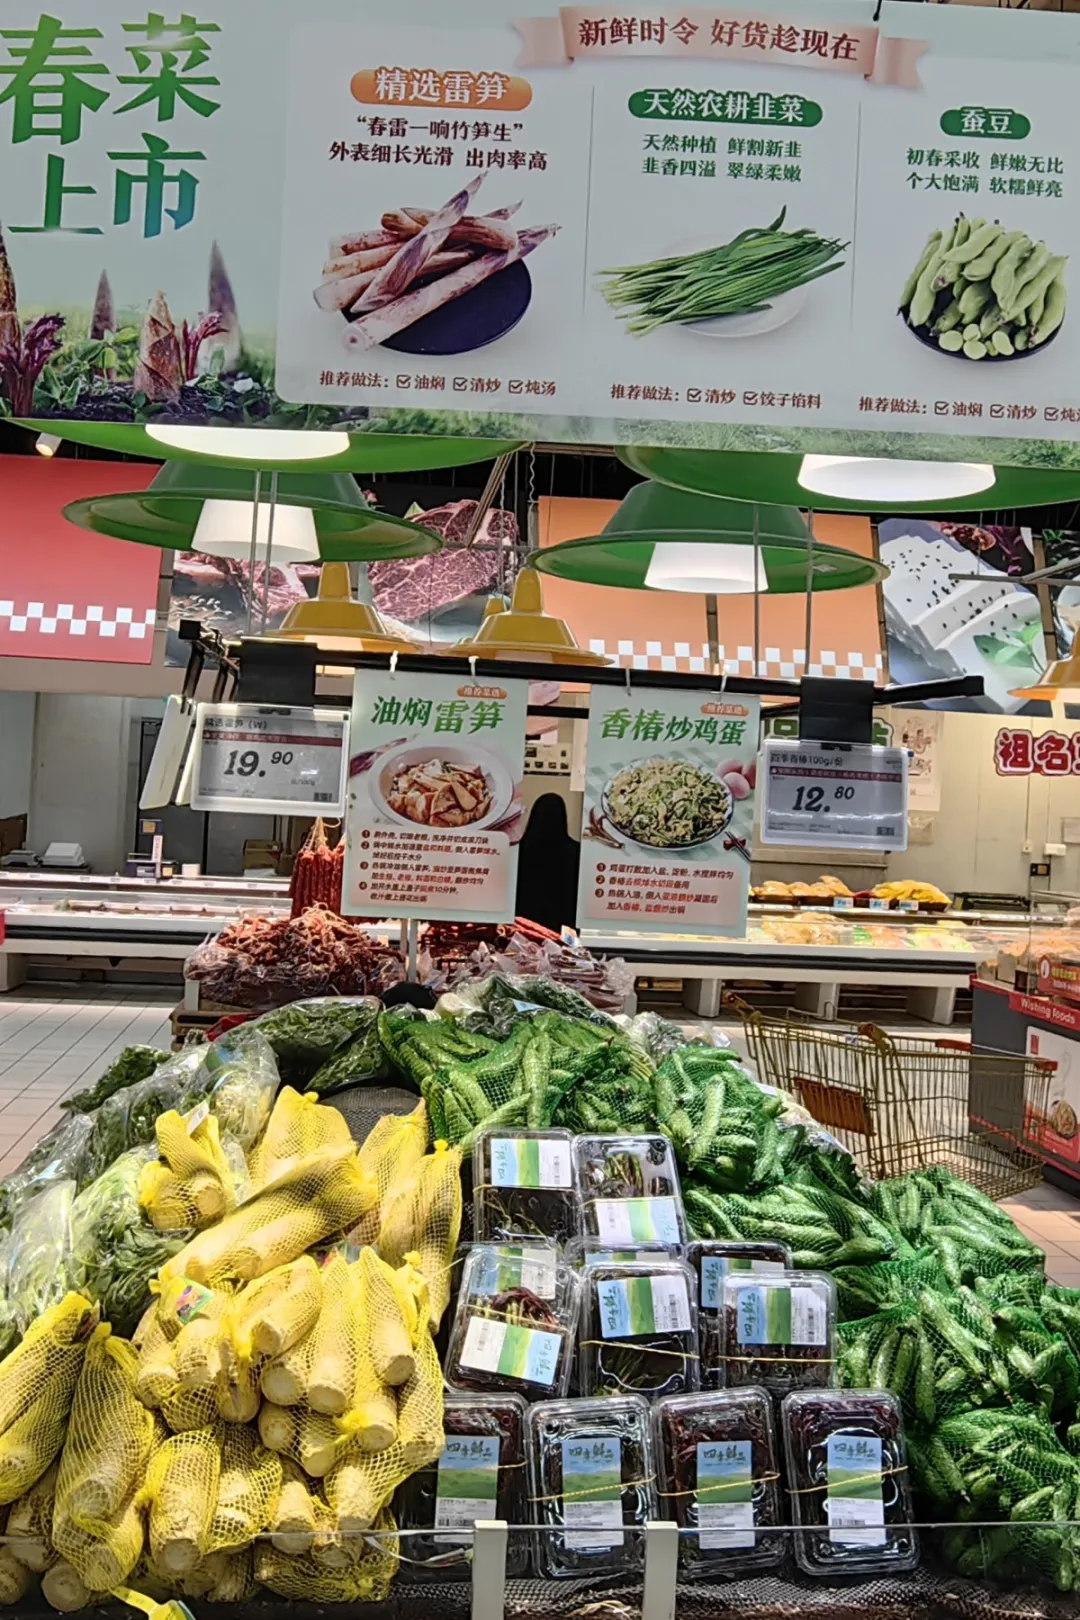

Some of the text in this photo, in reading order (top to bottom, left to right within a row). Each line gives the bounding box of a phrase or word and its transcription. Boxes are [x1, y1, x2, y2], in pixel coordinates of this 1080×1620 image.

[578, 16, 860, 61] 新鲜时令 好货趁现在
[0, 12, 222, 145] 春菜
[375, 68, 507, 104] 精选雷笋
[643, 90, 804, 123] 天然农耕韭菜
[961, 108, 1013, 135] 蚕豆
[329, 141, 548, 171] 外表细长光滑 出肉率高
[643, 133, 802, 158] 天然种植 鲜割新韭
[642, 157, 801, 182] 韭香四溢 翠绿柔嫩
[906, 148, 1064, 174] 初春采收 鲜嫩无比
[8, 132, 207, 239] 上市
[906, 172, 1063, 198] 个大饱满 软糯鲜亮
[414, 375, 446, 391] 油焖
[470, 378, 501, 393] 清炒
[525, 380, 556, 396] 炖汤
[705, 389, 736, 404] 清炒
[760, 391, 822, 409] 饺子馅料
[952, 401, 983, 417] 油焖
[1007, 404, 1038, 420] 清炒
[1060, 408, 1080, 422] 炖
[371, 696, 505, 734] 油焖雷笋
[601, 707, 747, 746] 香椿炒鸡蛋
[998, 730, 1080, 774] 祖名
